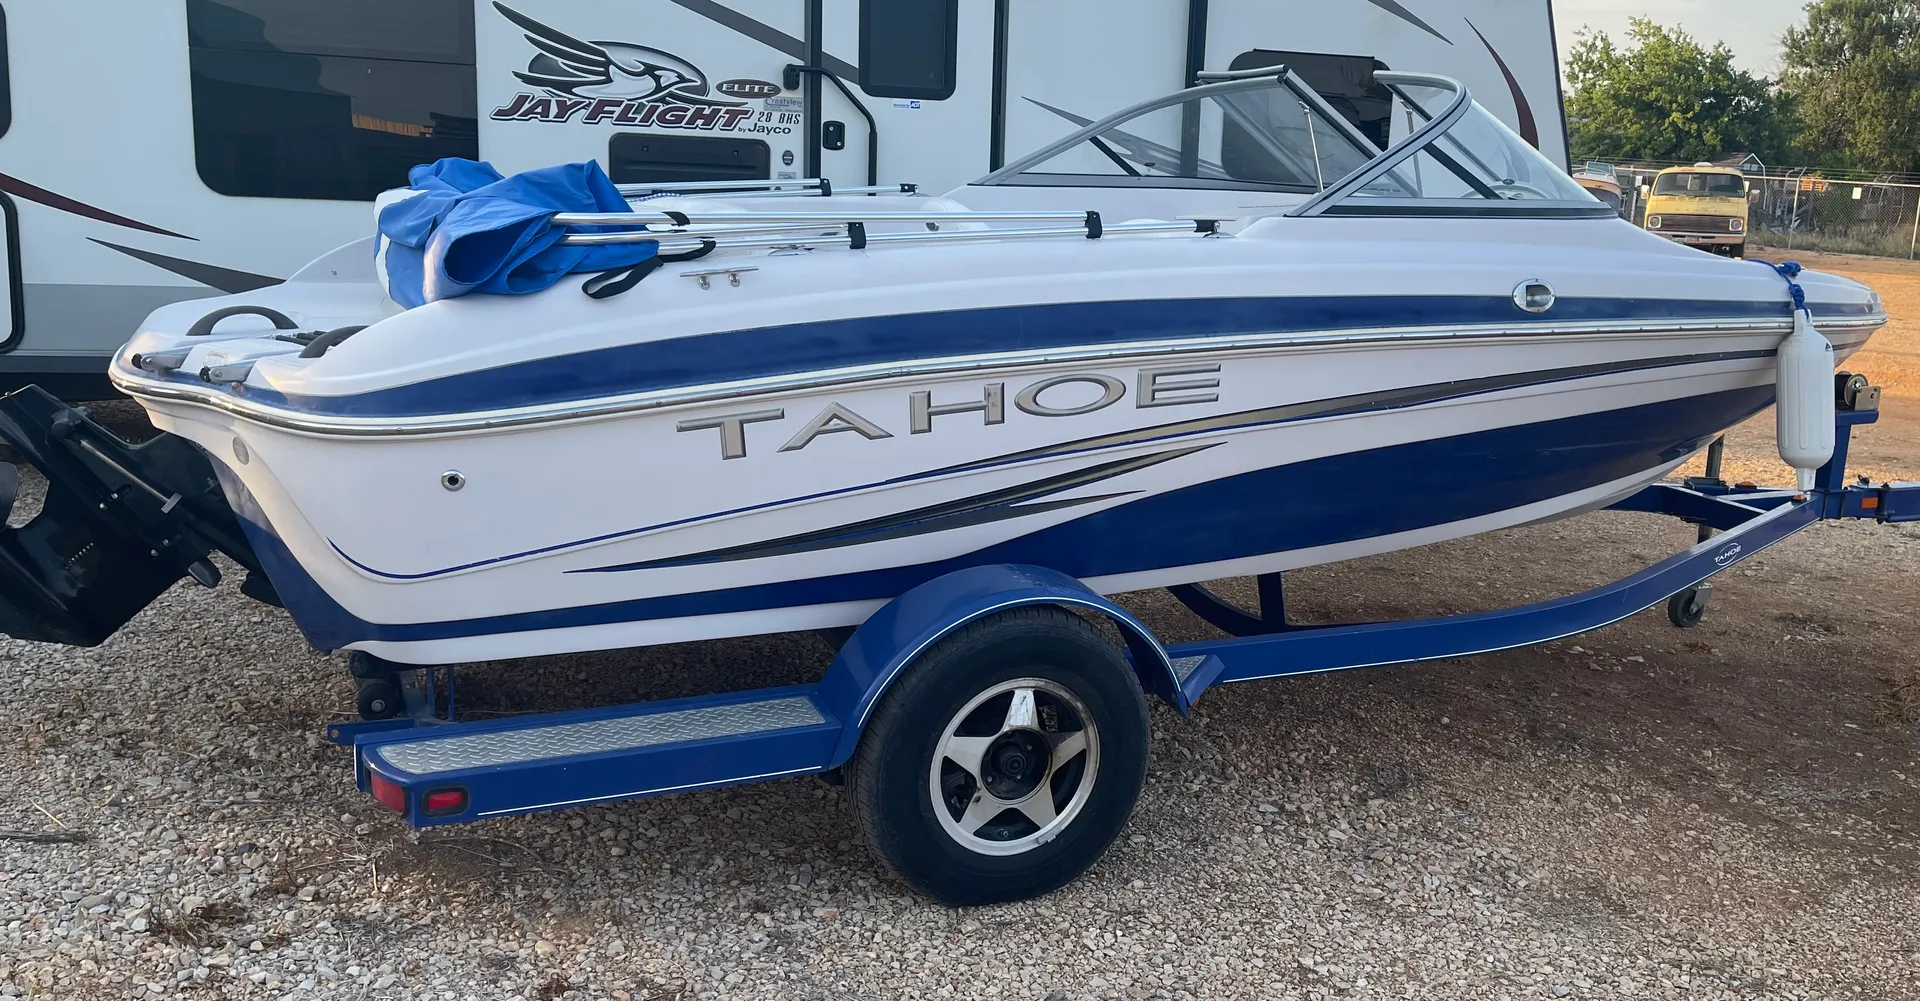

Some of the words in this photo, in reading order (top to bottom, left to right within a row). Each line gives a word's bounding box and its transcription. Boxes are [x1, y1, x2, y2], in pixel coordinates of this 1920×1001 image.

[722, 83, 775, 94] ELITE
[490, 92, 588, 122] JAY
[582, 97, 754, 131] FLIGHT
[757, 111, 773, 123] 28
[779, 112, 801, 125] BHS
[748, 122, 791, 136] Jayco
[676, 363, 1221, 461] TAHOE
[1714, 545, 1742, 563] TAHOE
